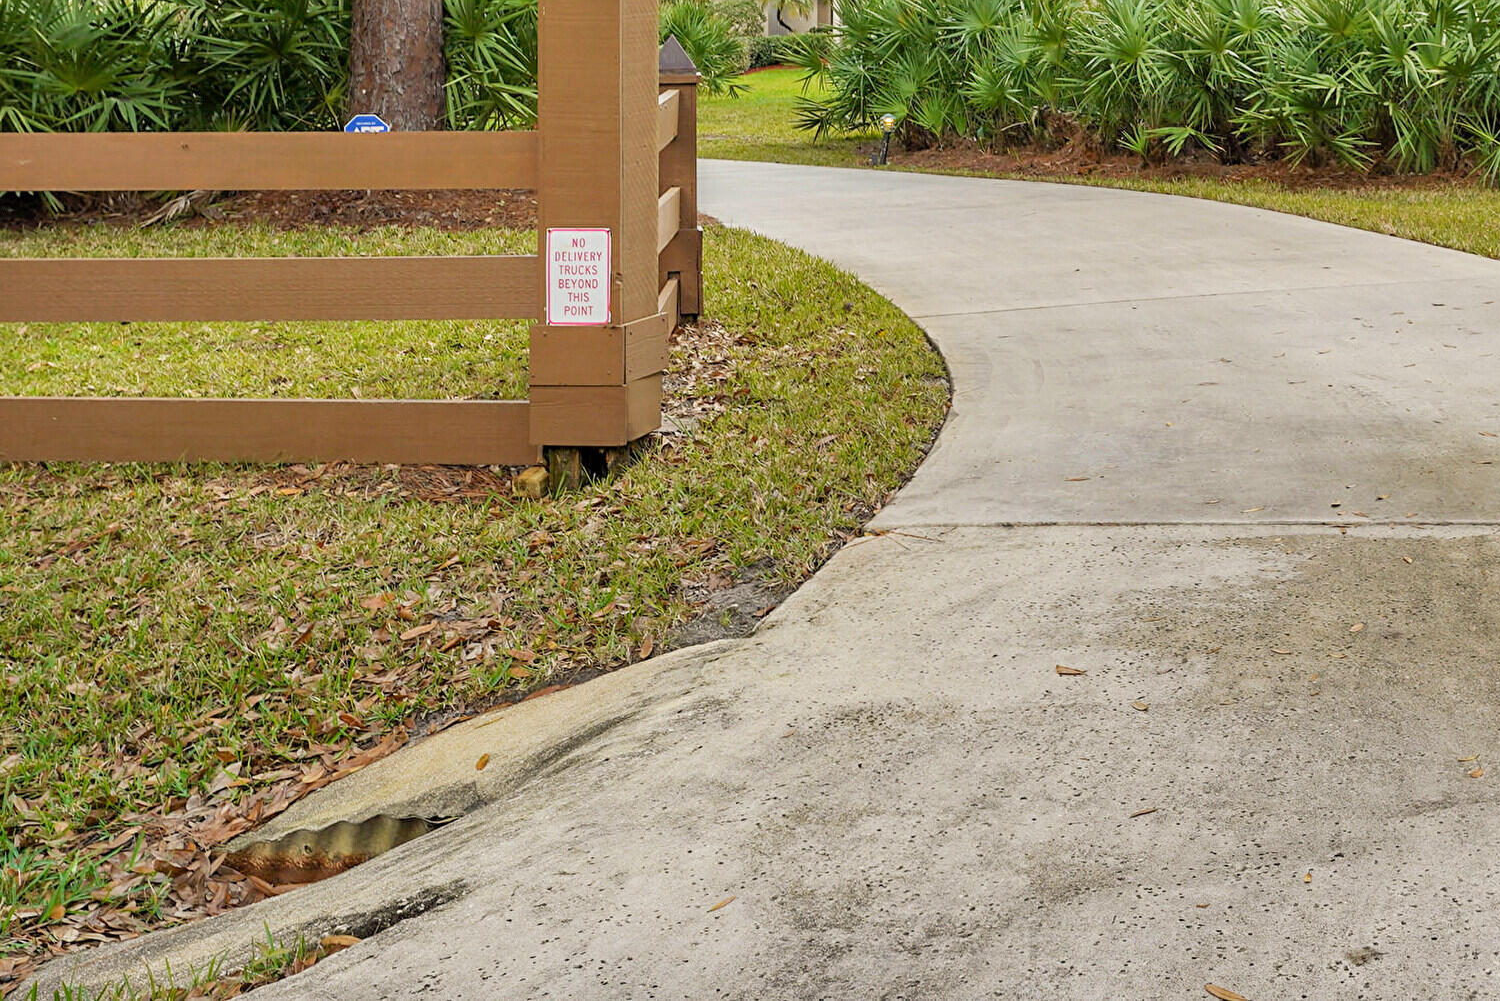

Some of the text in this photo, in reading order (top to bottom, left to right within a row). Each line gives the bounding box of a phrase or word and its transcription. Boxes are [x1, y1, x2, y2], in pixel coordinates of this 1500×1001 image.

[572, 238, 585, 247] NO
[555, 251, 602, 261] DELIVERY
[560, 265, 597, 275] TRUCKS
[558, 279, 598, 289] BEYOND
[568, 292, 589, 302] THIS
[564, 306, 593, 316] POINT
